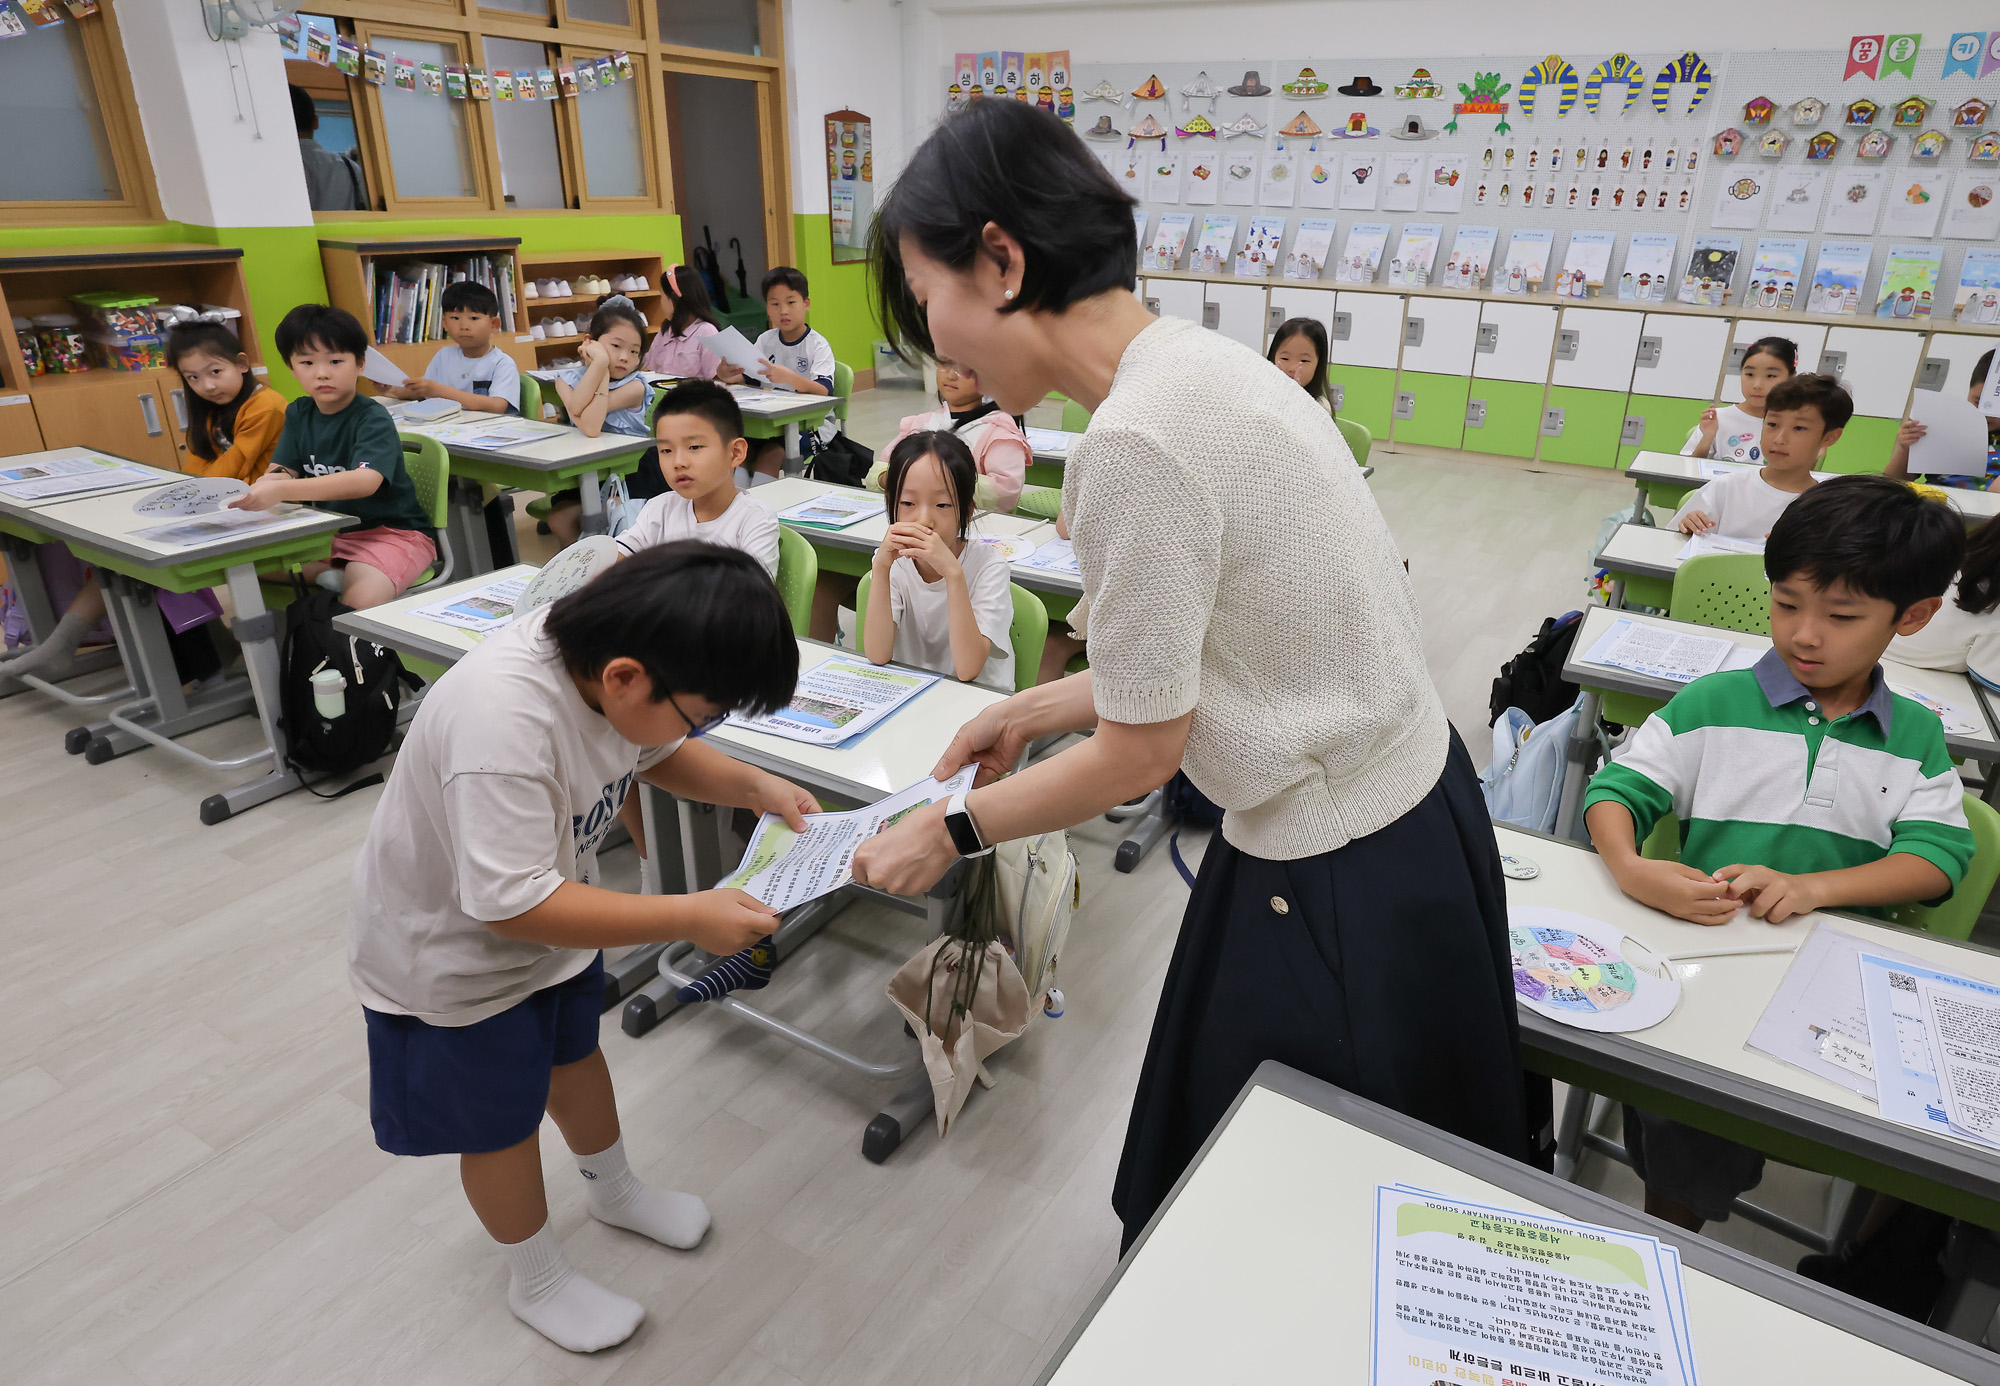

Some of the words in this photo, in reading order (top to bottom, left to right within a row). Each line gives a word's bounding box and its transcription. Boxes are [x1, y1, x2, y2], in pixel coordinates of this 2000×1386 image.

[1859, 39, 1909, 61] 꿈을
[961, 71, 1065, 86] 생일축하해
[575, 831, 602, 859] NEW
[1424, 1201, 1459, 1214] SCHOOL
[1461, 1209, 1518, 1226] ELEMENTARY
[1469, 1218, 1561, 1245] 서울중평초등학교
[1520, 1220, 1574, 1236] JUNGPYONG
[1576, 1231, 1606, 1243] SEOUL
[1395, 1249, 1411, 1259] 키워
[1485, 1245, 1504, 1256] 22일
[1496, 1240, 1571, 1262] 서울중평초등학교장
[1505, 1249, 1519, 1259] 7월
[1413, 1253, 1429, 1264] 꿈을
[1431, 1257, 1455, 1269] 행복한
[1520, 1252, 1550, 1265] 2026년
[1395, 1257, 1444, 1275] 칭찬해주시고,
[1456, 1263, 1488, 1277] 실천하여
[1447, 1269, 1463, 1280] 점은
[1465, 1273, 1482, 1284] 잘한
[1490, 1271, 1522, 1284] 설정하고
[1505, 1266, 1541, 1280] 바랍니다.
[1542, 1273, 1566, 1285] 주시기
[1395, 1278, 1419, 1290] 생활한
[1420, 1284, 1445, 1296] 배우고
[1484, 1277, 1524, 1293] 참고하시어
[1524, 1277, 1548, 1290] 방향을
[1550, 1283, 1568, 1295] 나은
[1568, 1279, 1593, 1291] 지도해
[1595, 1284, 1620, 1296] 있도록
[1447, 1289, 1479, 1304] 학생들이
[1527, 1286, 1551, 1299] 내용을
[1554, 1292, 1579, 1305] 안내된
[1569, 1287, 1586, 1298] 보다
[1588, 1291, 1605, 1302] 점은
[1633, 1292, 1650, 1303] 나갈
[1395, 1302, 1411, 1313] 행복
[1481, 1297, 1497, 1308] 동안
[1500, 1301, 1521, 1313] 1학기
[1503, 1294, 1547, 1311] 자료입니다.
[1581, 1298, 1639, 1318] 학부모님께서는
[1618, 1297, 1652, 1311] 개선해야
[1414, 1306, 1434, 1318] 배움,
[1523, 1307, 1571, 1324] 2026학년도
[1549, 1304, 1574, 1316] 드리는
[1576, 1309, 1601, 1322] 안내해
[1395, 1311, 1427, 1325] 지향하는
[1436, 1312, 1461, 1325] 즐거운
[1464, 1317, 1484, 1330] 학교,
[1491, 1316, 1528, 1331] 있습니다.
[1603, 1316, 1629, 1329] 결과를
[1429, 1319, 1478, 1337] 교육과정에서
[1529, 1324, 1563, 1339] 구현하고
[1631, 1321, 1657, 1334] 과정과
[1480, 1331, 1505, 1344] 통하여
[1565, 1332, 1591, 1345] 목표를
[1508, 1337, 1550, 1354] 체험활동을
[1571, 1342, 1597, 1356] 인성을
[1593, 1338, 1611, 1351] 위한
[1449, 1348, 1503, 1372] 튼튼하게
[1552, 1347, 1578, 1361] 창의적
[1600, 1349, 1626, 1362] 키우고
[1408, 1354, 1447, 1374] 어린이
[1581, 1354, 1624, 1371] 교과학습과
[1629, 1355, 1664, 1371] 창의성을
[1454, 1366, 1495, 1386] 행복한
[1509, 1363, 1551, 1383] 바르며
[1594, 1366, 1648, 1385] 안녕하십니까?
[1626, 1364, 1652, 1377] 본교는
